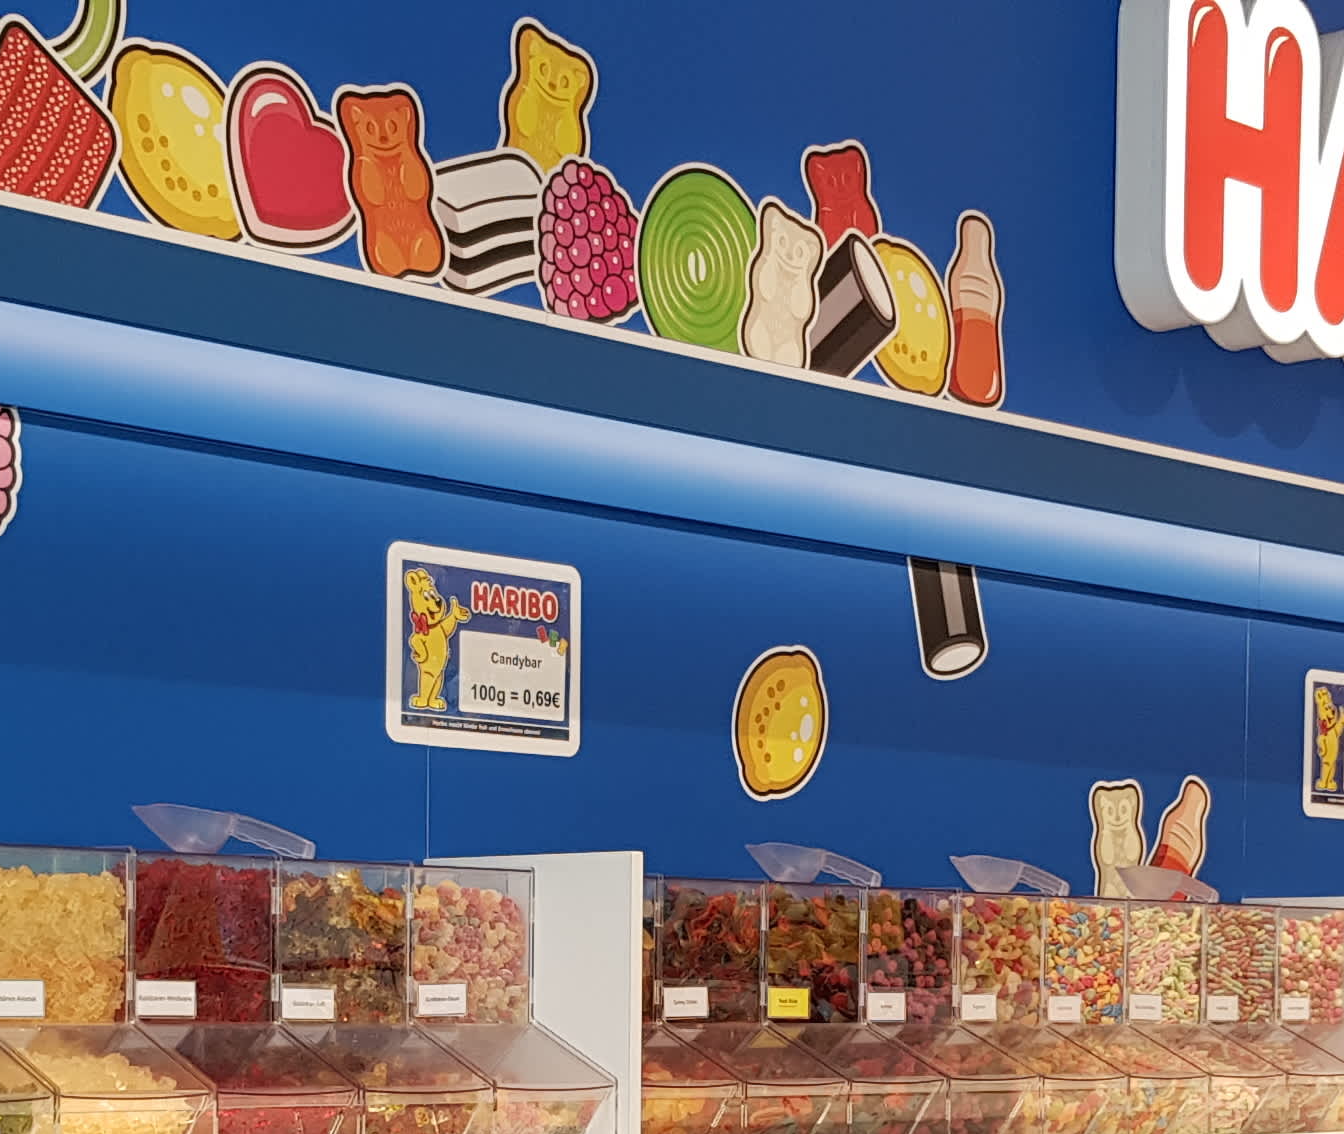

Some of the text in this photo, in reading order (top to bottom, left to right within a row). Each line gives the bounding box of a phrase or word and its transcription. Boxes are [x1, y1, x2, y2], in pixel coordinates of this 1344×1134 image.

[471, 582, 558, 622] HARIBO
[491, 651, 543, 670] Candybar
[471, 684, 506, 707] 100g
[523, 689, 561, 709] 0,69€
